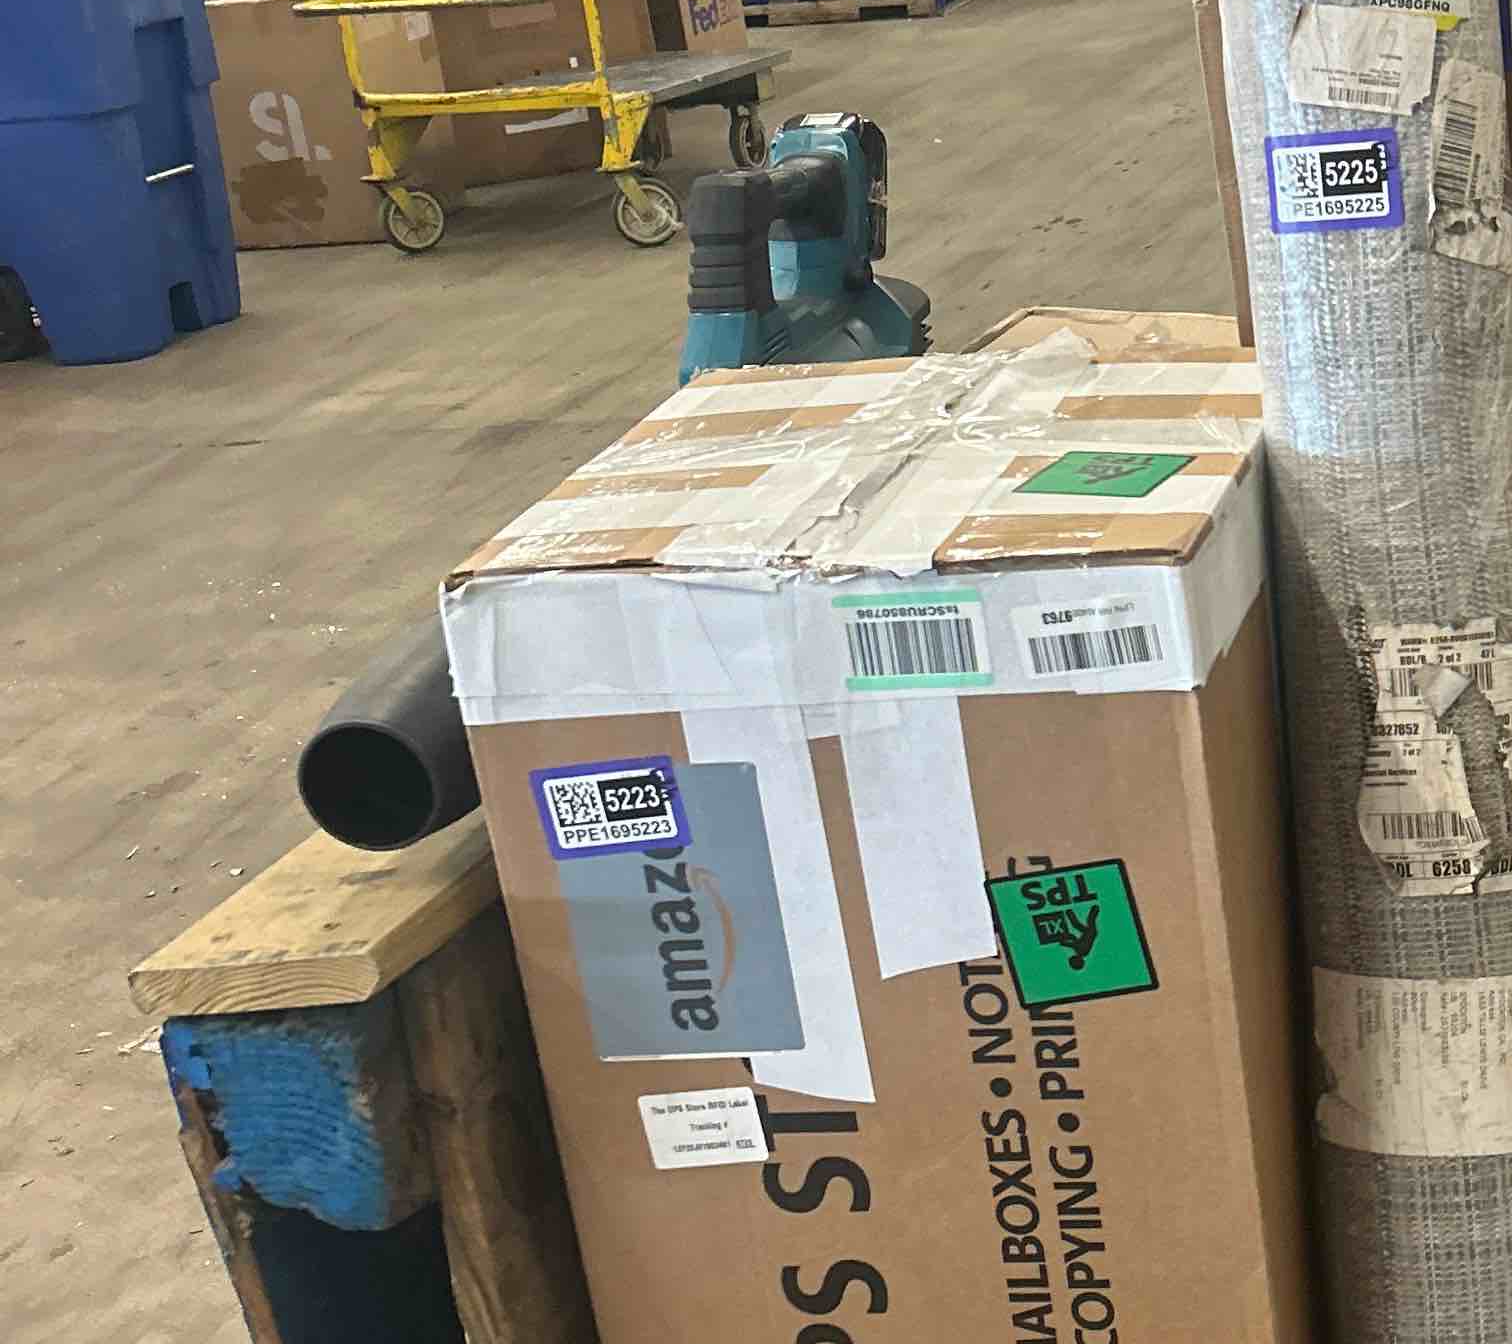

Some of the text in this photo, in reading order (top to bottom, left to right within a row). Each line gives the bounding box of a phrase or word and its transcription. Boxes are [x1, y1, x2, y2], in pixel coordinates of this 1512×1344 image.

[1325, 158, 1378, 186] 5225
[604, 784, 661, 813] 5223
[563, 819, 672, 845] PPE1695223
[1019, 874, 1097, 912] TPS
